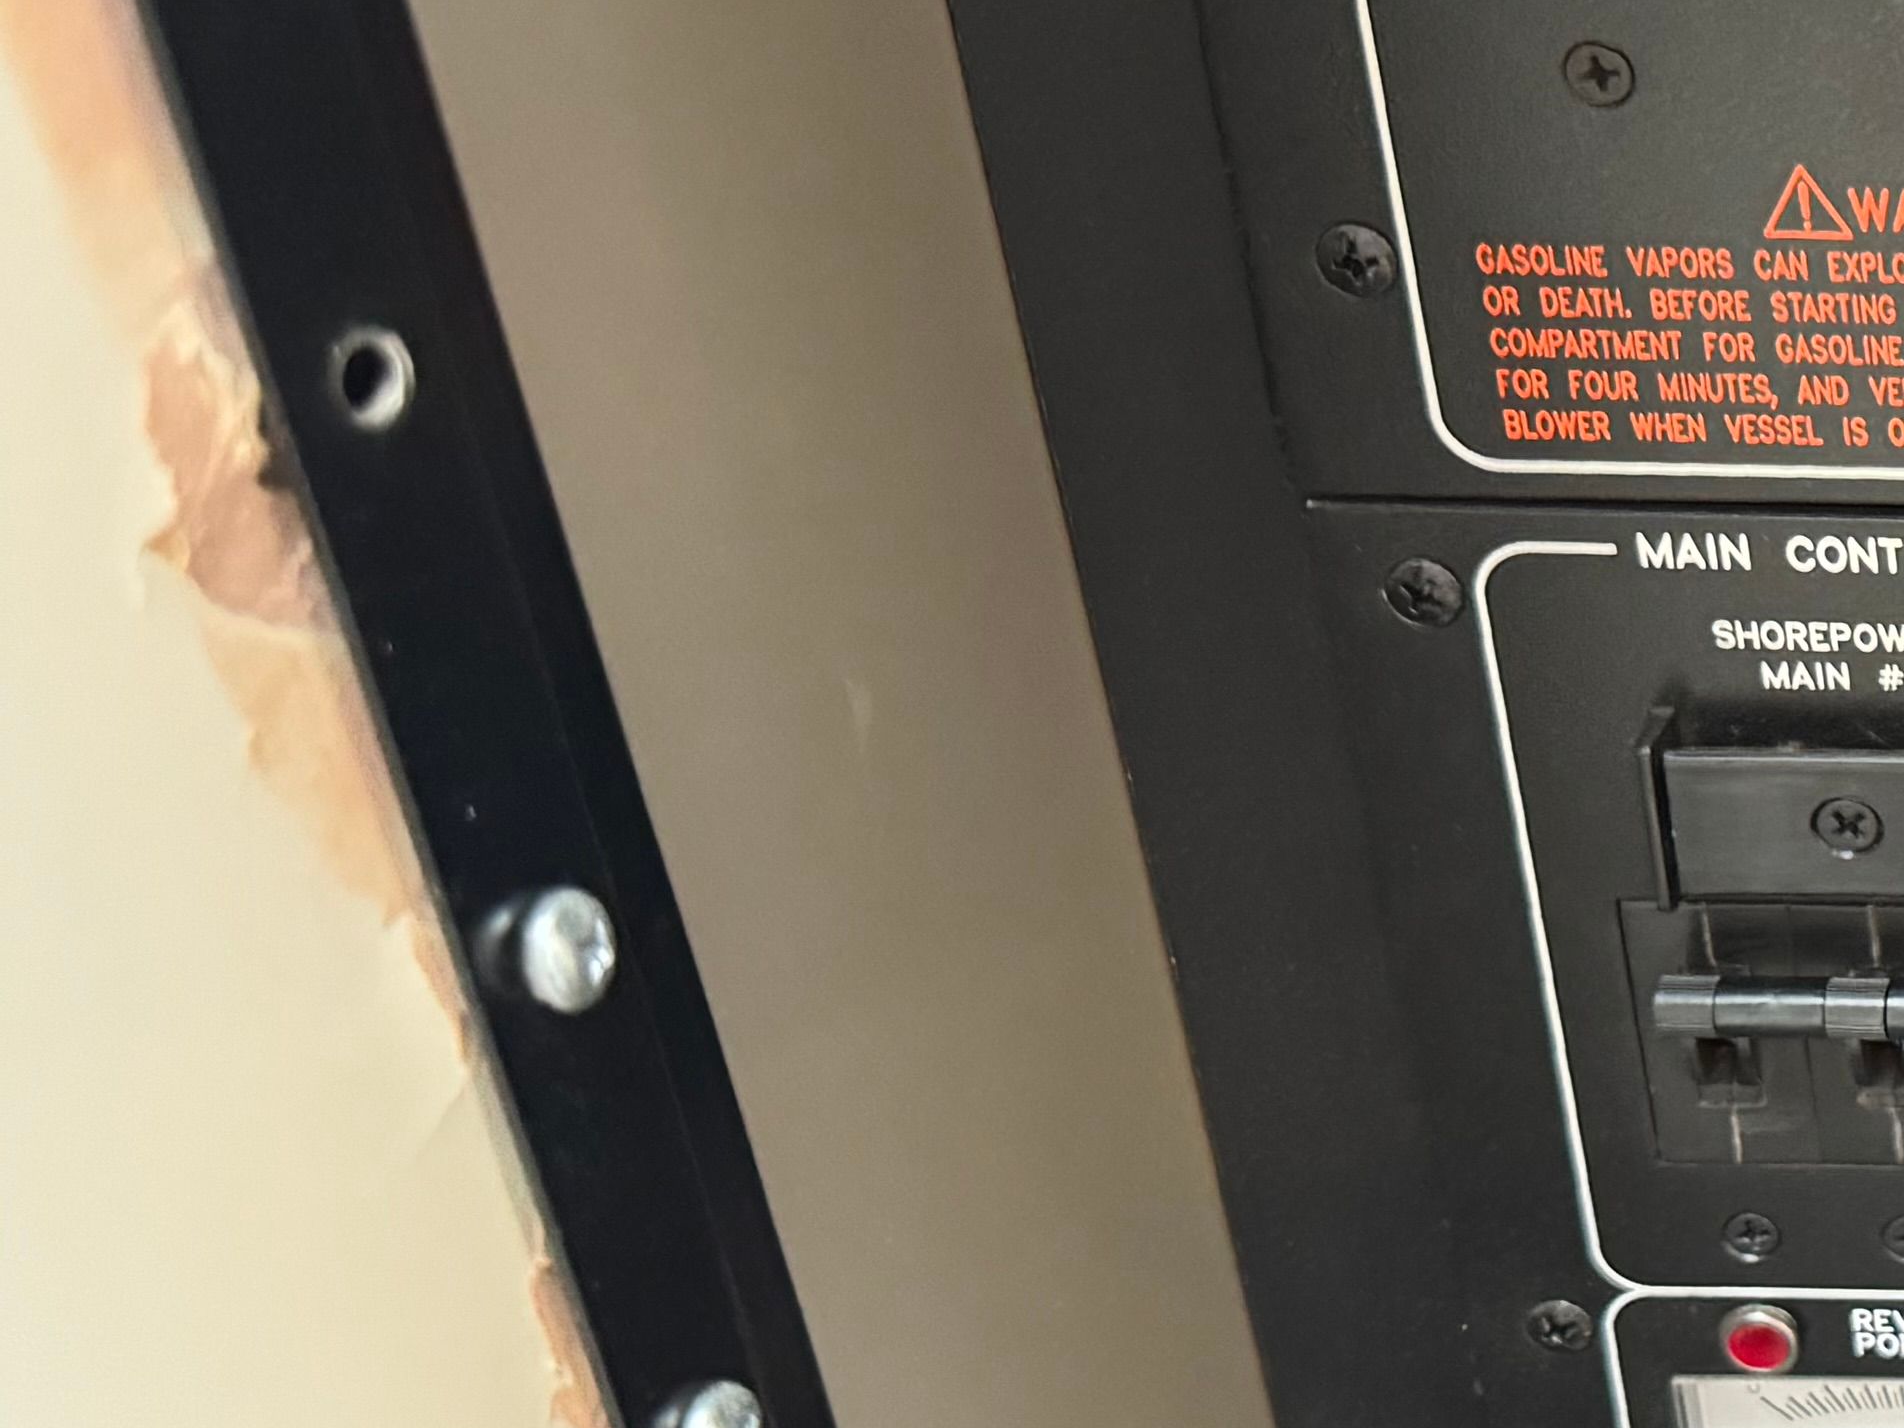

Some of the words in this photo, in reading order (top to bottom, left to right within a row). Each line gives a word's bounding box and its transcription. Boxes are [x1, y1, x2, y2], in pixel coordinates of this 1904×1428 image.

[1475, 243, 1609, 279] GASOLINE
[1627, 246, 1736, 281] VAPORS
[1754, 248, 1810, 283] CAN
[1635, 531, 1752, 572] MAIN
[1759, 660, 1851, 691] MAIN
